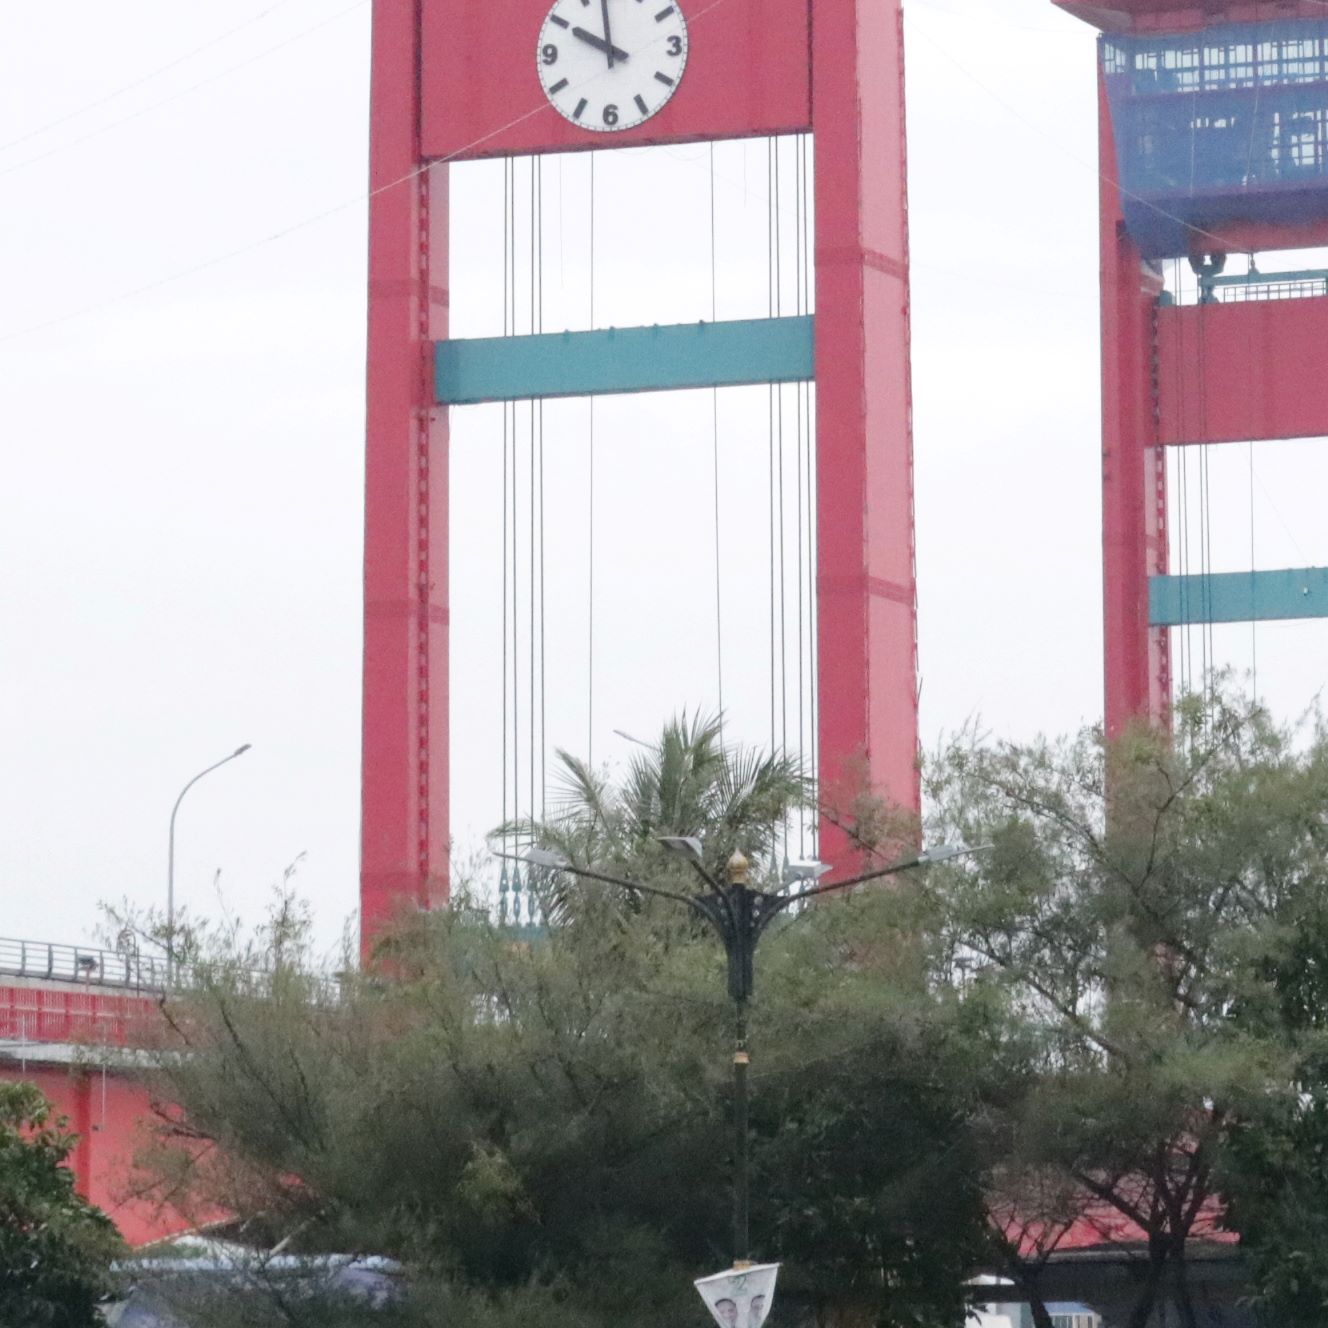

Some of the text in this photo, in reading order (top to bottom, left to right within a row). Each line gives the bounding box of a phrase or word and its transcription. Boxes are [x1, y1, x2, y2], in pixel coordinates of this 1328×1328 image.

[542, 43, 558, 65] 9
[666, 35, 682, 56] 3
[602, 104, 619, 126] 6
